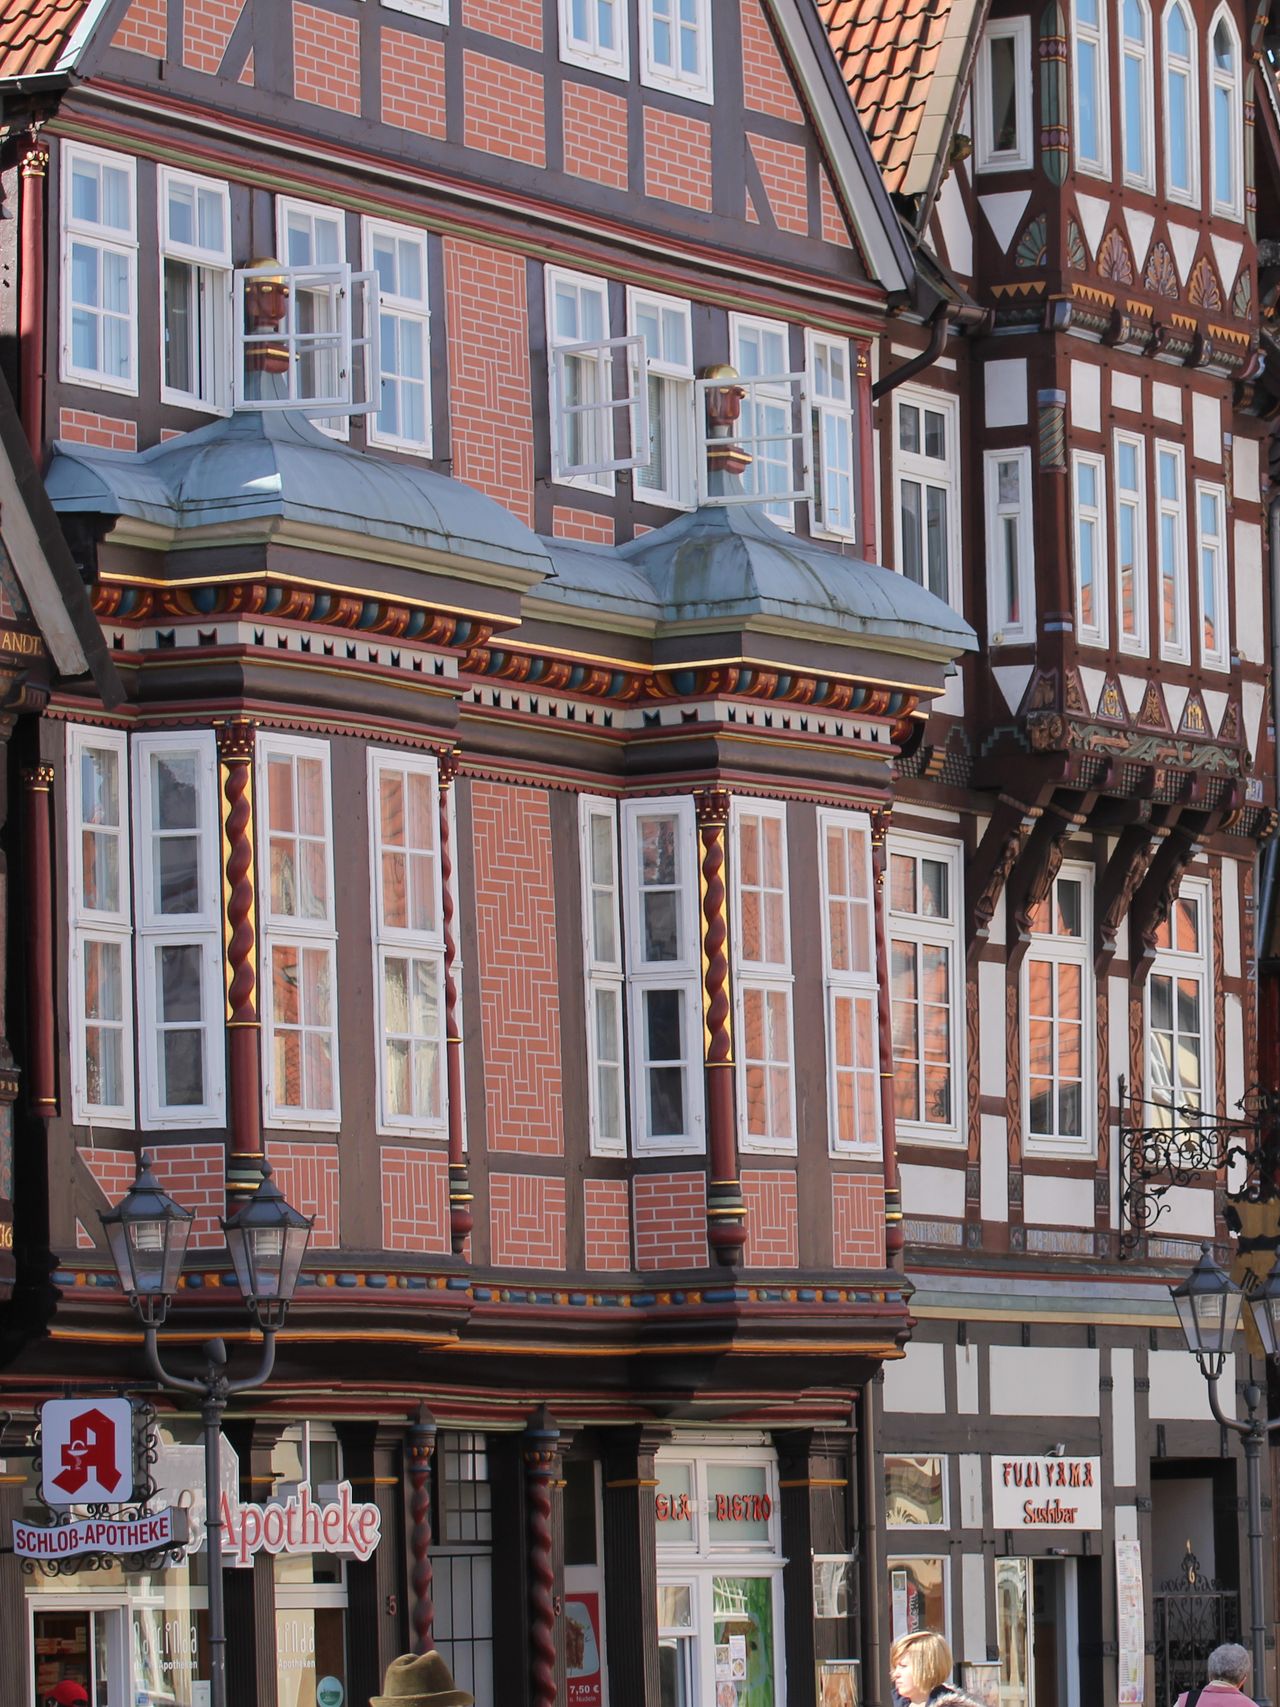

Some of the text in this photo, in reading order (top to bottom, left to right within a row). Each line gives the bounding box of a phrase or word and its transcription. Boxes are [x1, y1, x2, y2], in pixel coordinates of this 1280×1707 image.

[716, 1493, 772, 1522] BISTRO
[1023, 1499, 1078, 1524] Sushibar
[219, 1488, 376, 1563] Apotheke
[569, 1685, 590, 1695] 7,50
